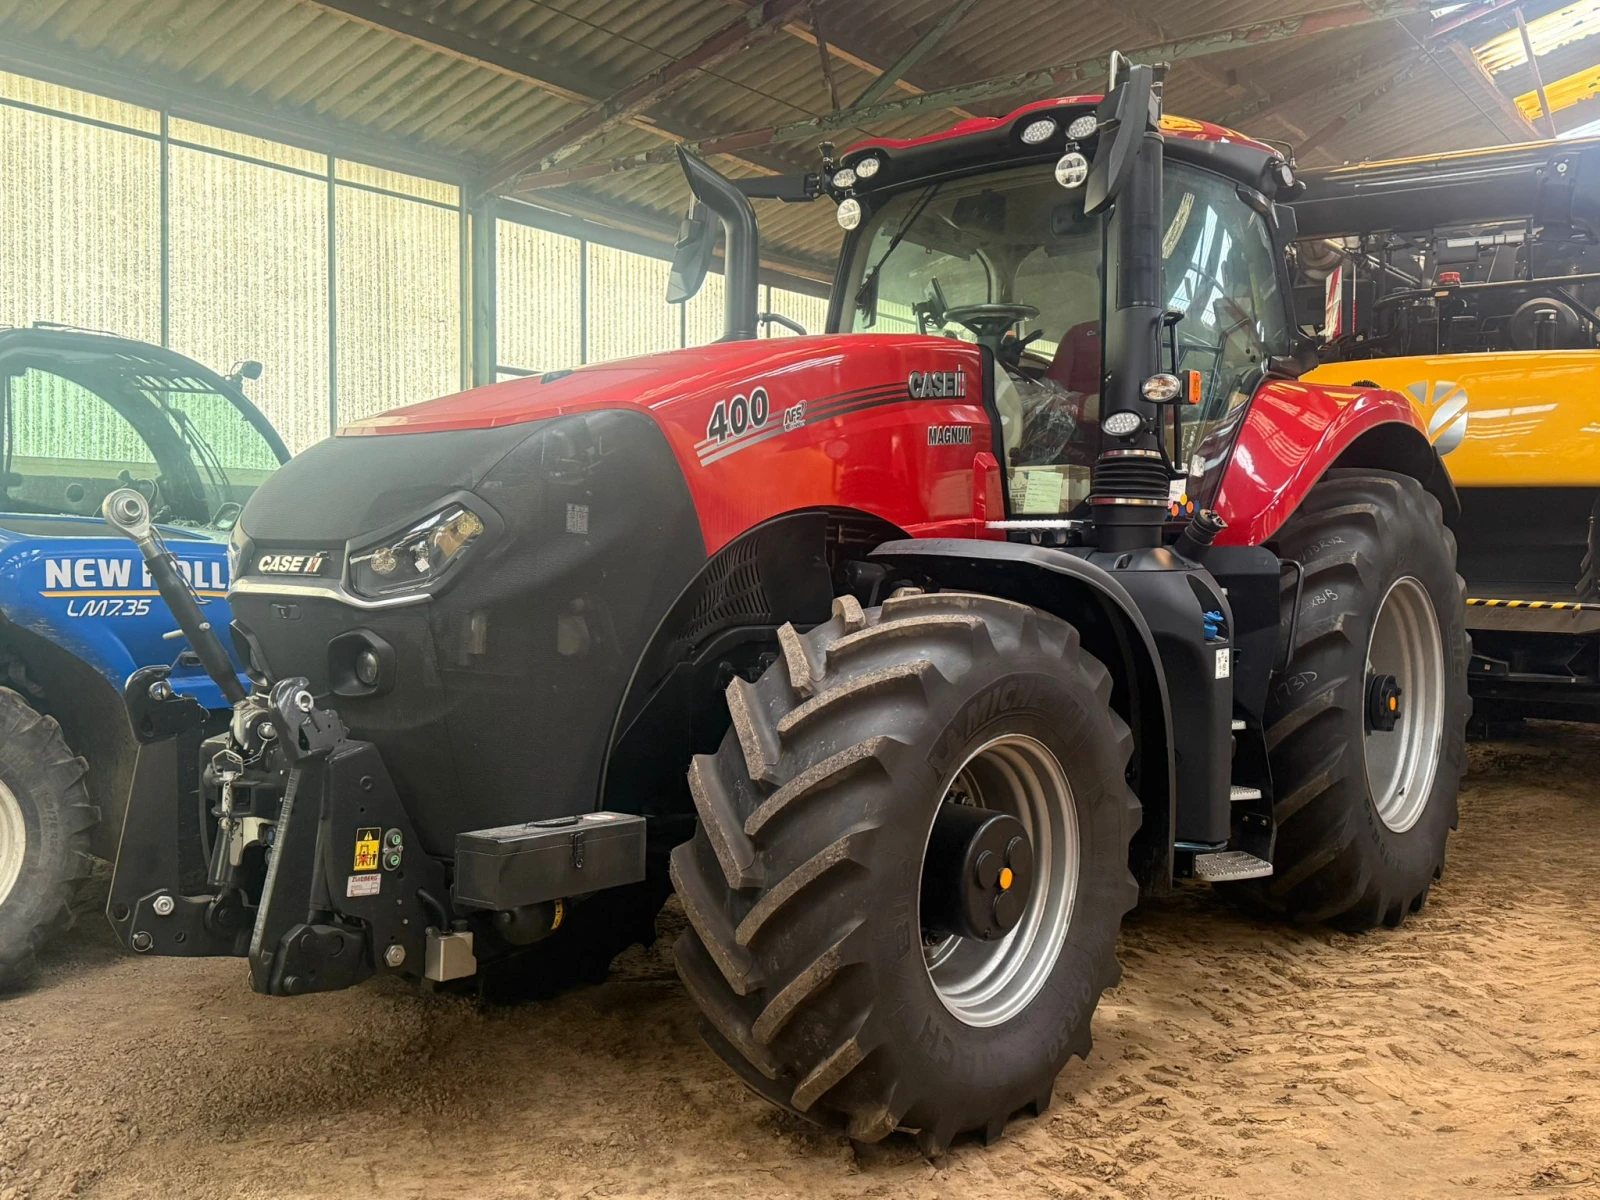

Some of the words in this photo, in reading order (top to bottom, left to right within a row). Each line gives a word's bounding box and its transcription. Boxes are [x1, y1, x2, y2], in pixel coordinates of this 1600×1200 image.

[706, 386, 770, 444] 400
[927, 425, 972, 446] MAGNUM
[45, 559, 131, 588] NEW
[142, 560, 230, 590] OLL
[258, 555, 304, 572] CASE
